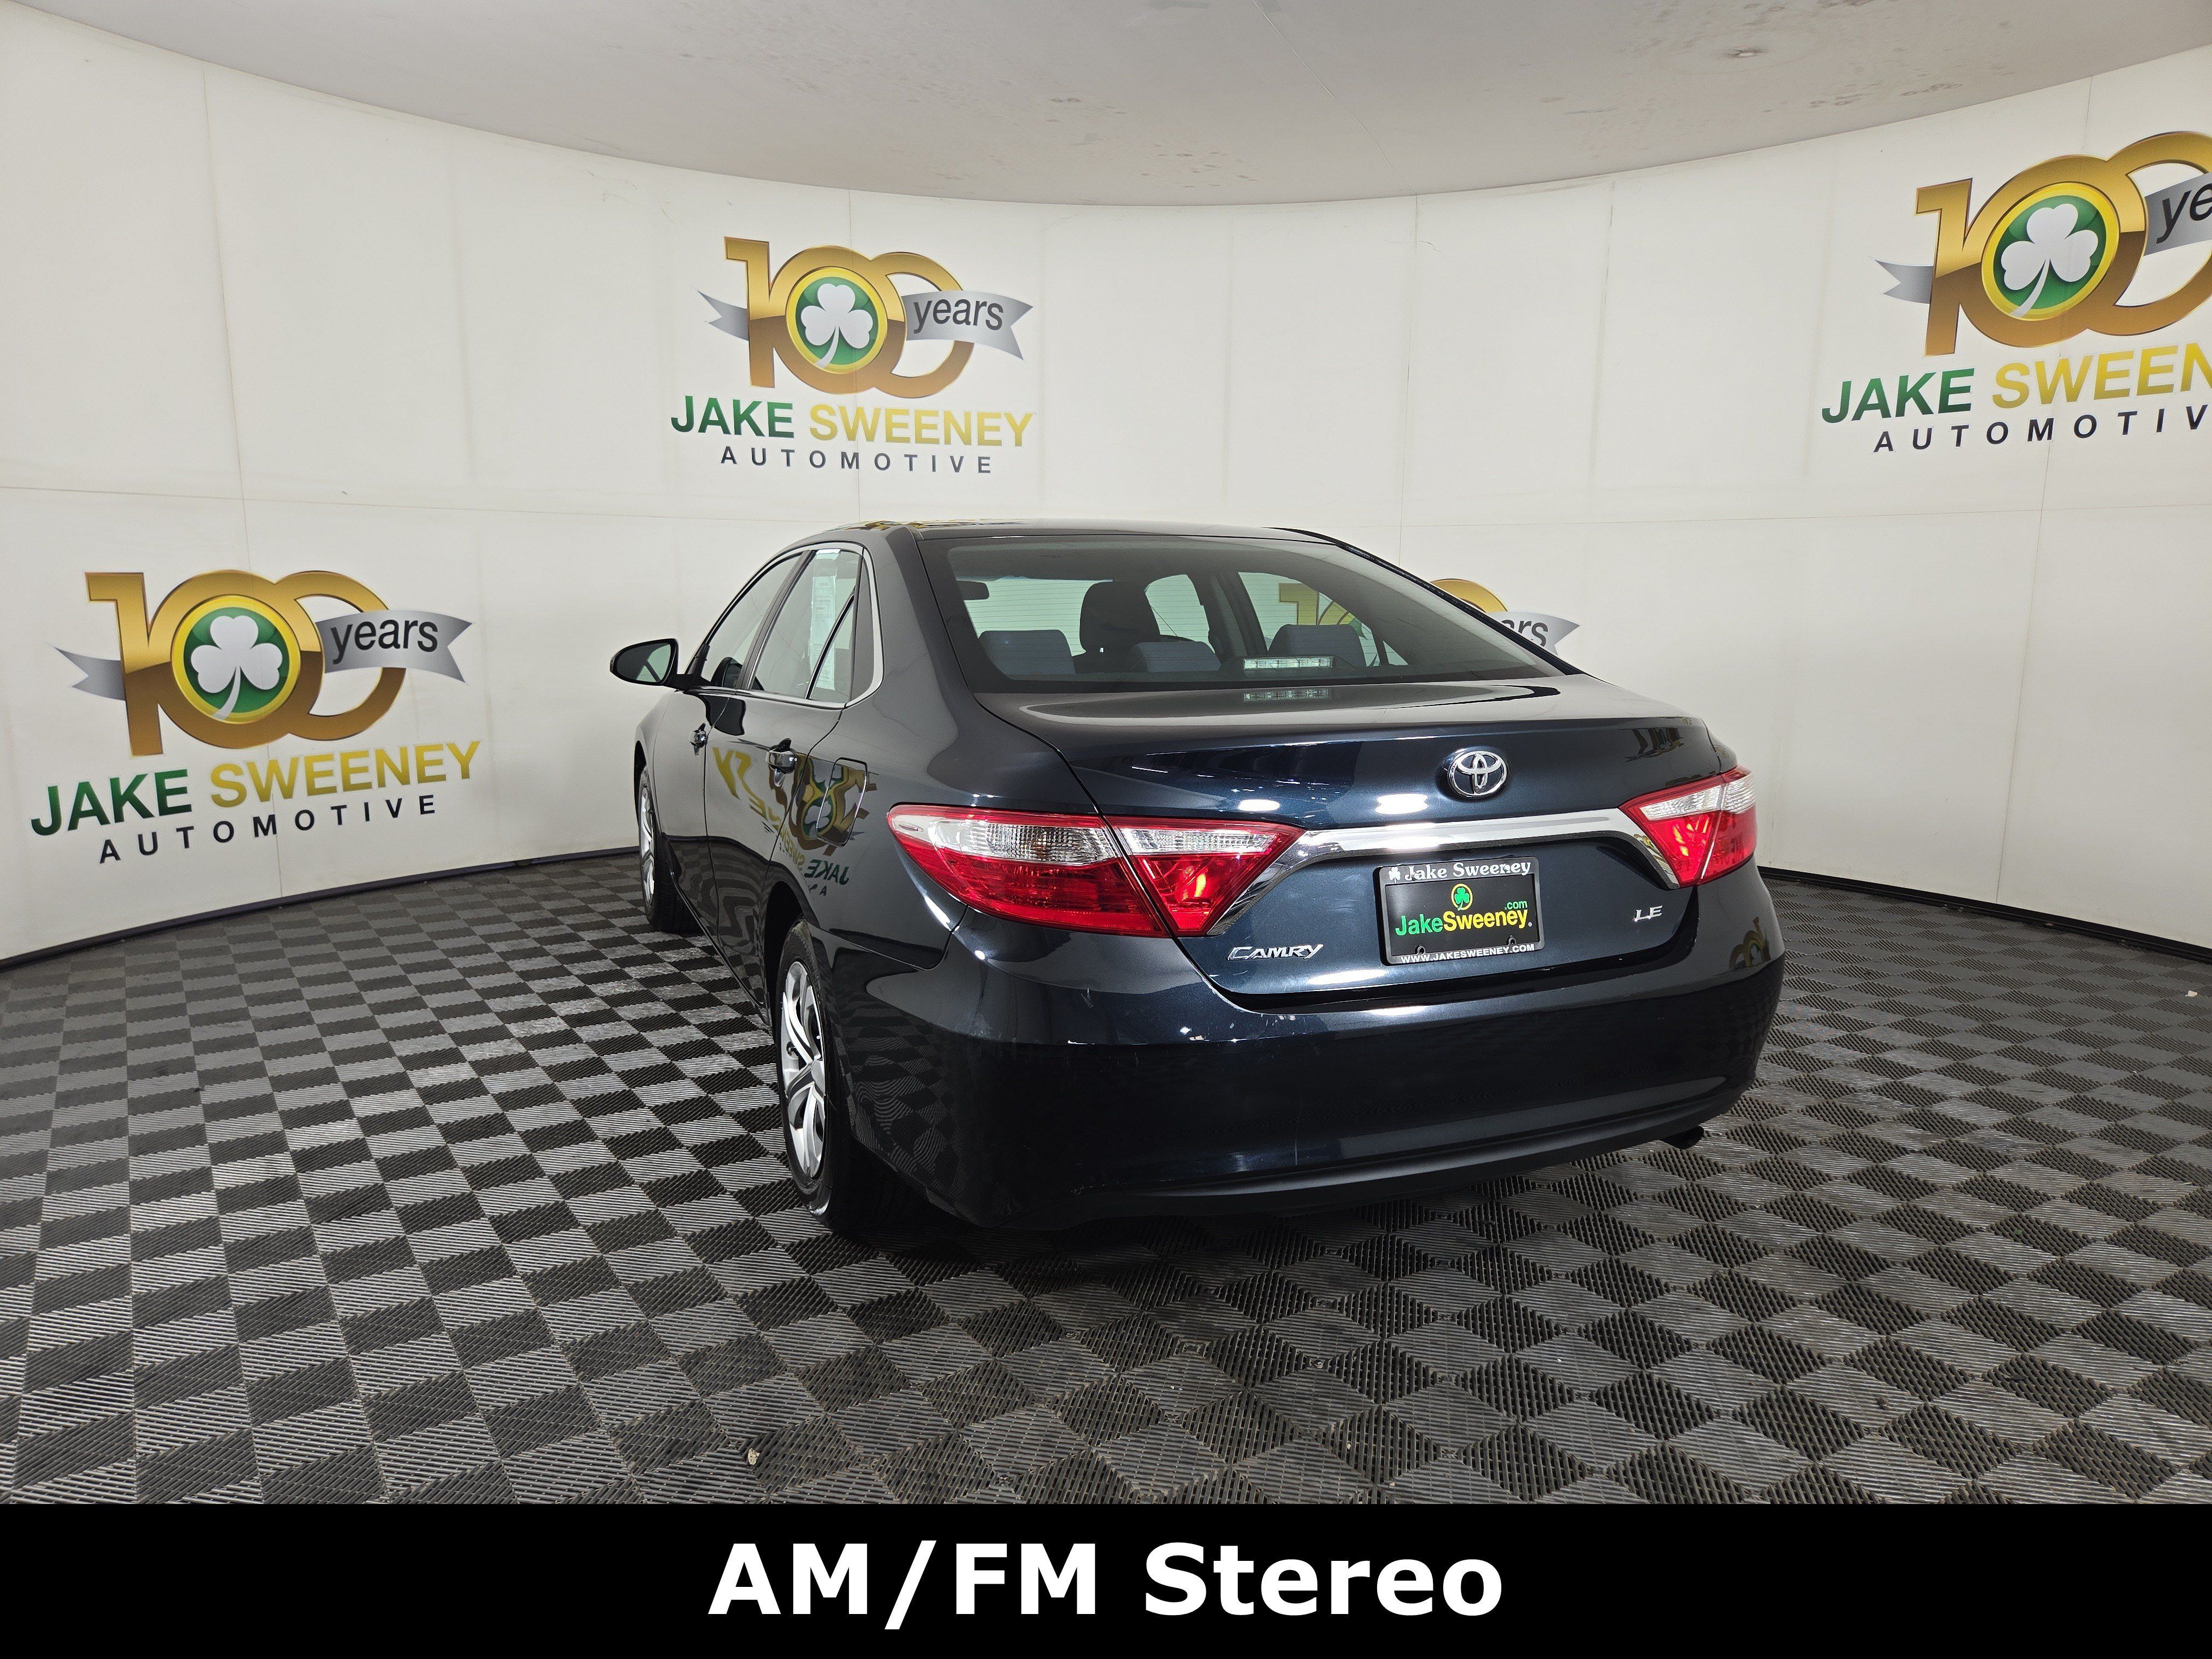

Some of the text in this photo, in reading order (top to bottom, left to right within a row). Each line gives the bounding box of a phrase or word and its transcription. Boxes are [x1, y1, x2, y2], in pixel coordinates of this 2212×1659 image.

[724, 236, 975, 398] 100
[913, 298, 1004, 334] years
[1822, 368, 1975, 423] JAKE
[671, 395, 1033, 447] JAKE SWEENEY
[1874, 404, 2208, 453] AUTOMOTIV
[721, 446, 991, 474] AUTOMOTIVE
[85, 569, 407, 757] 100
[331, 620, 438, 664] years
[31, 741, 481, 837] JAKE SWEENEY
[99, 794, 436, 864] AUTOMOTIVE
[1405, 862, 1531, 881] Jake Sweeney
[1632, 905, 1663, 922] LE
[1227, 944, 1324, 961] CAMRY
[1400, 943, 1535, 964] WWW.JAKESWEENEY.COM
